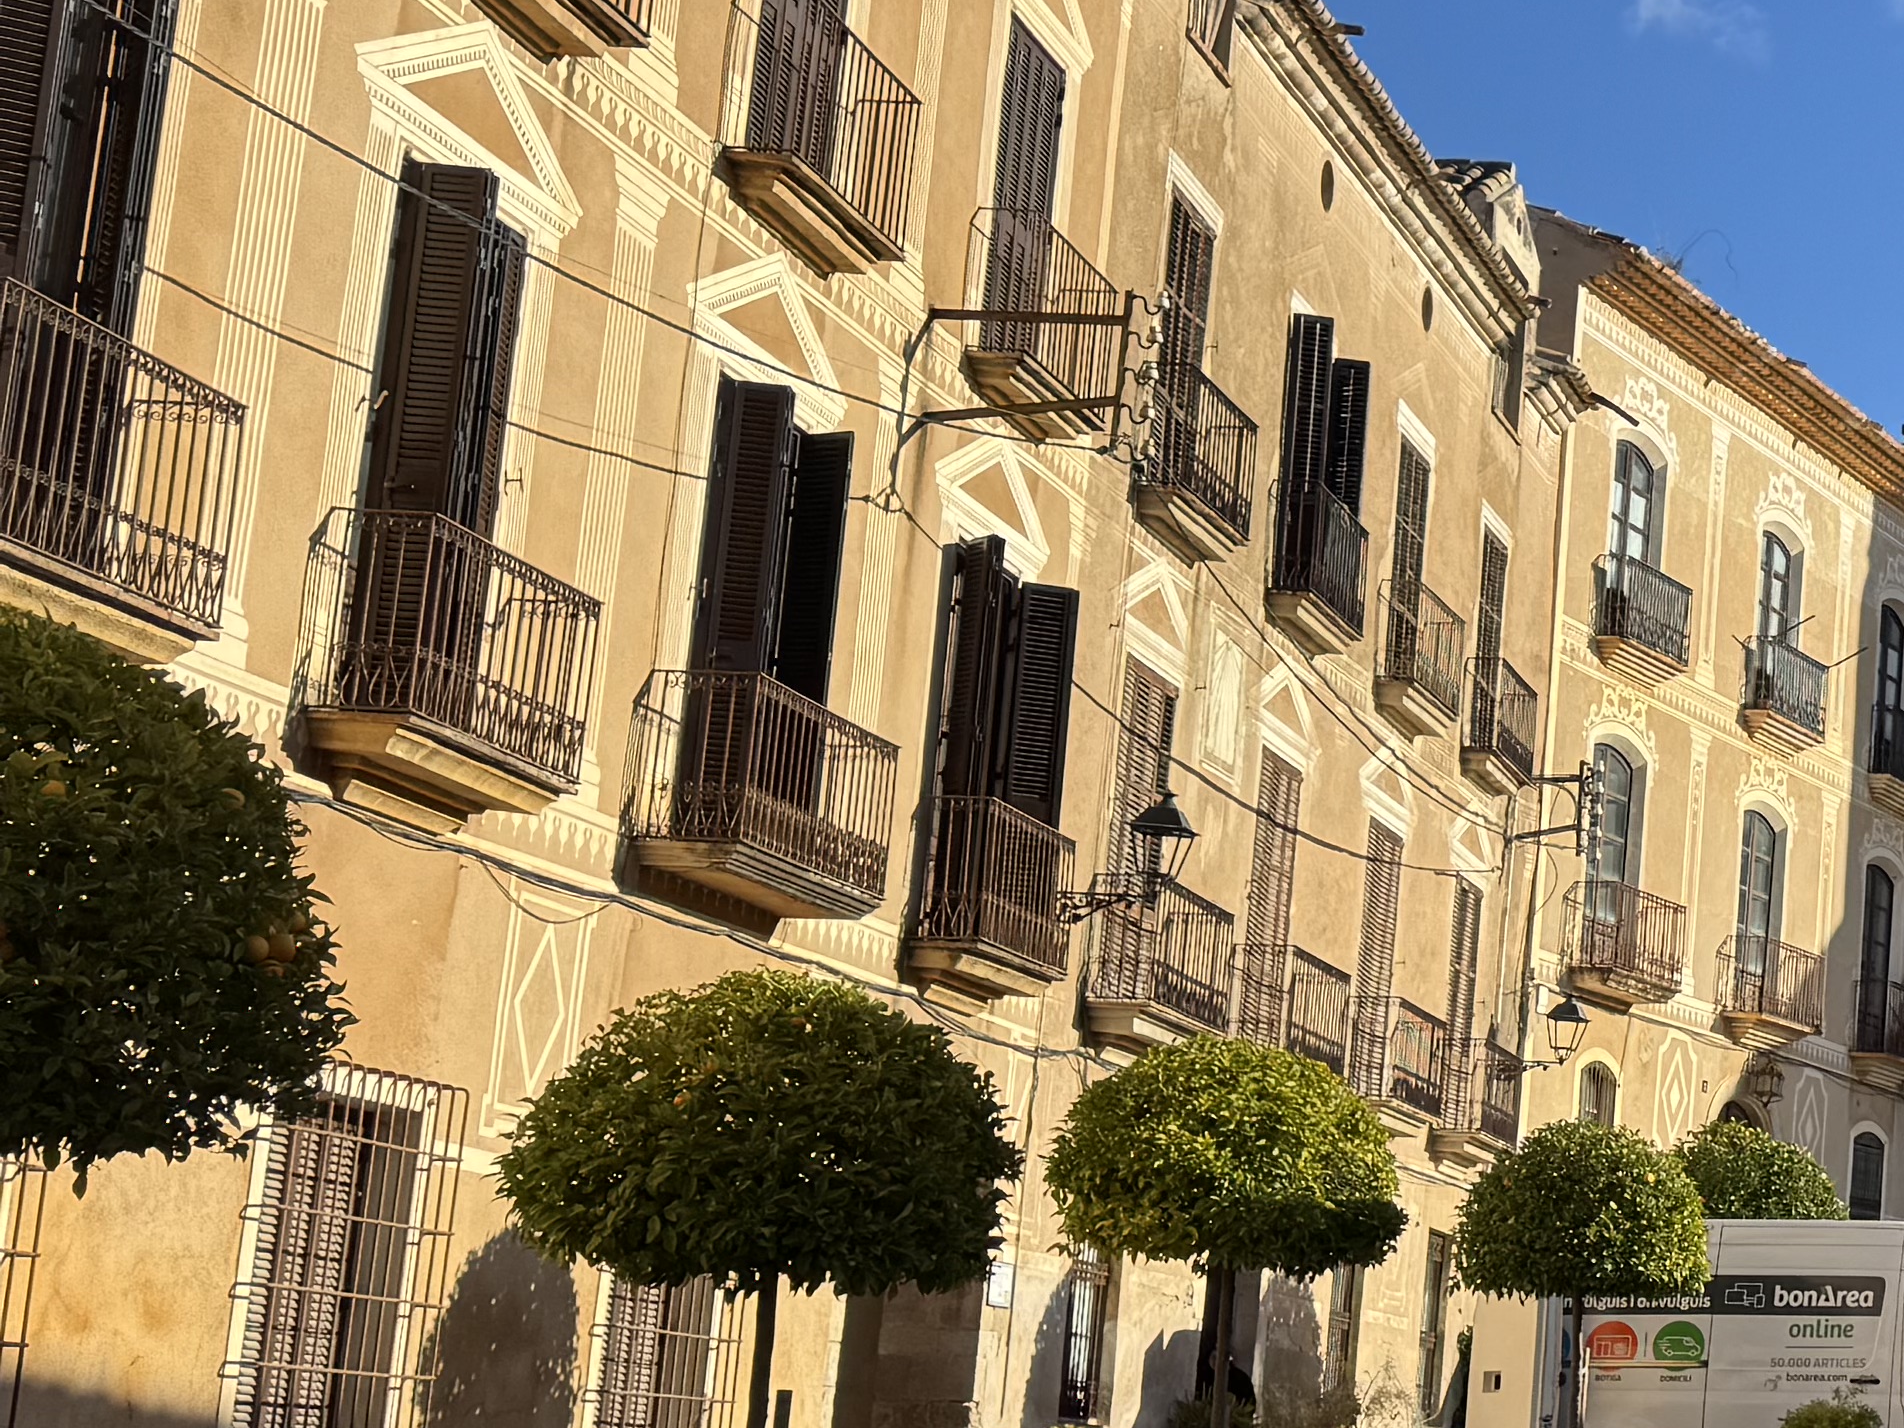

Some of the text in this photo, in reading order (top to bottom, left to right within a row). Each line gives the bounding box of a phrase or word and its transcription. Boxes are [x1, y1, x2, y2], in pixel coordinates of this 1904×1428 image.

[1788, 1319, 1855, 1339] online
[1770, 1357, 1867, 1369] 50.000 ARTICLES
[1786, 1372, 1848, 1382] bonarea.com
